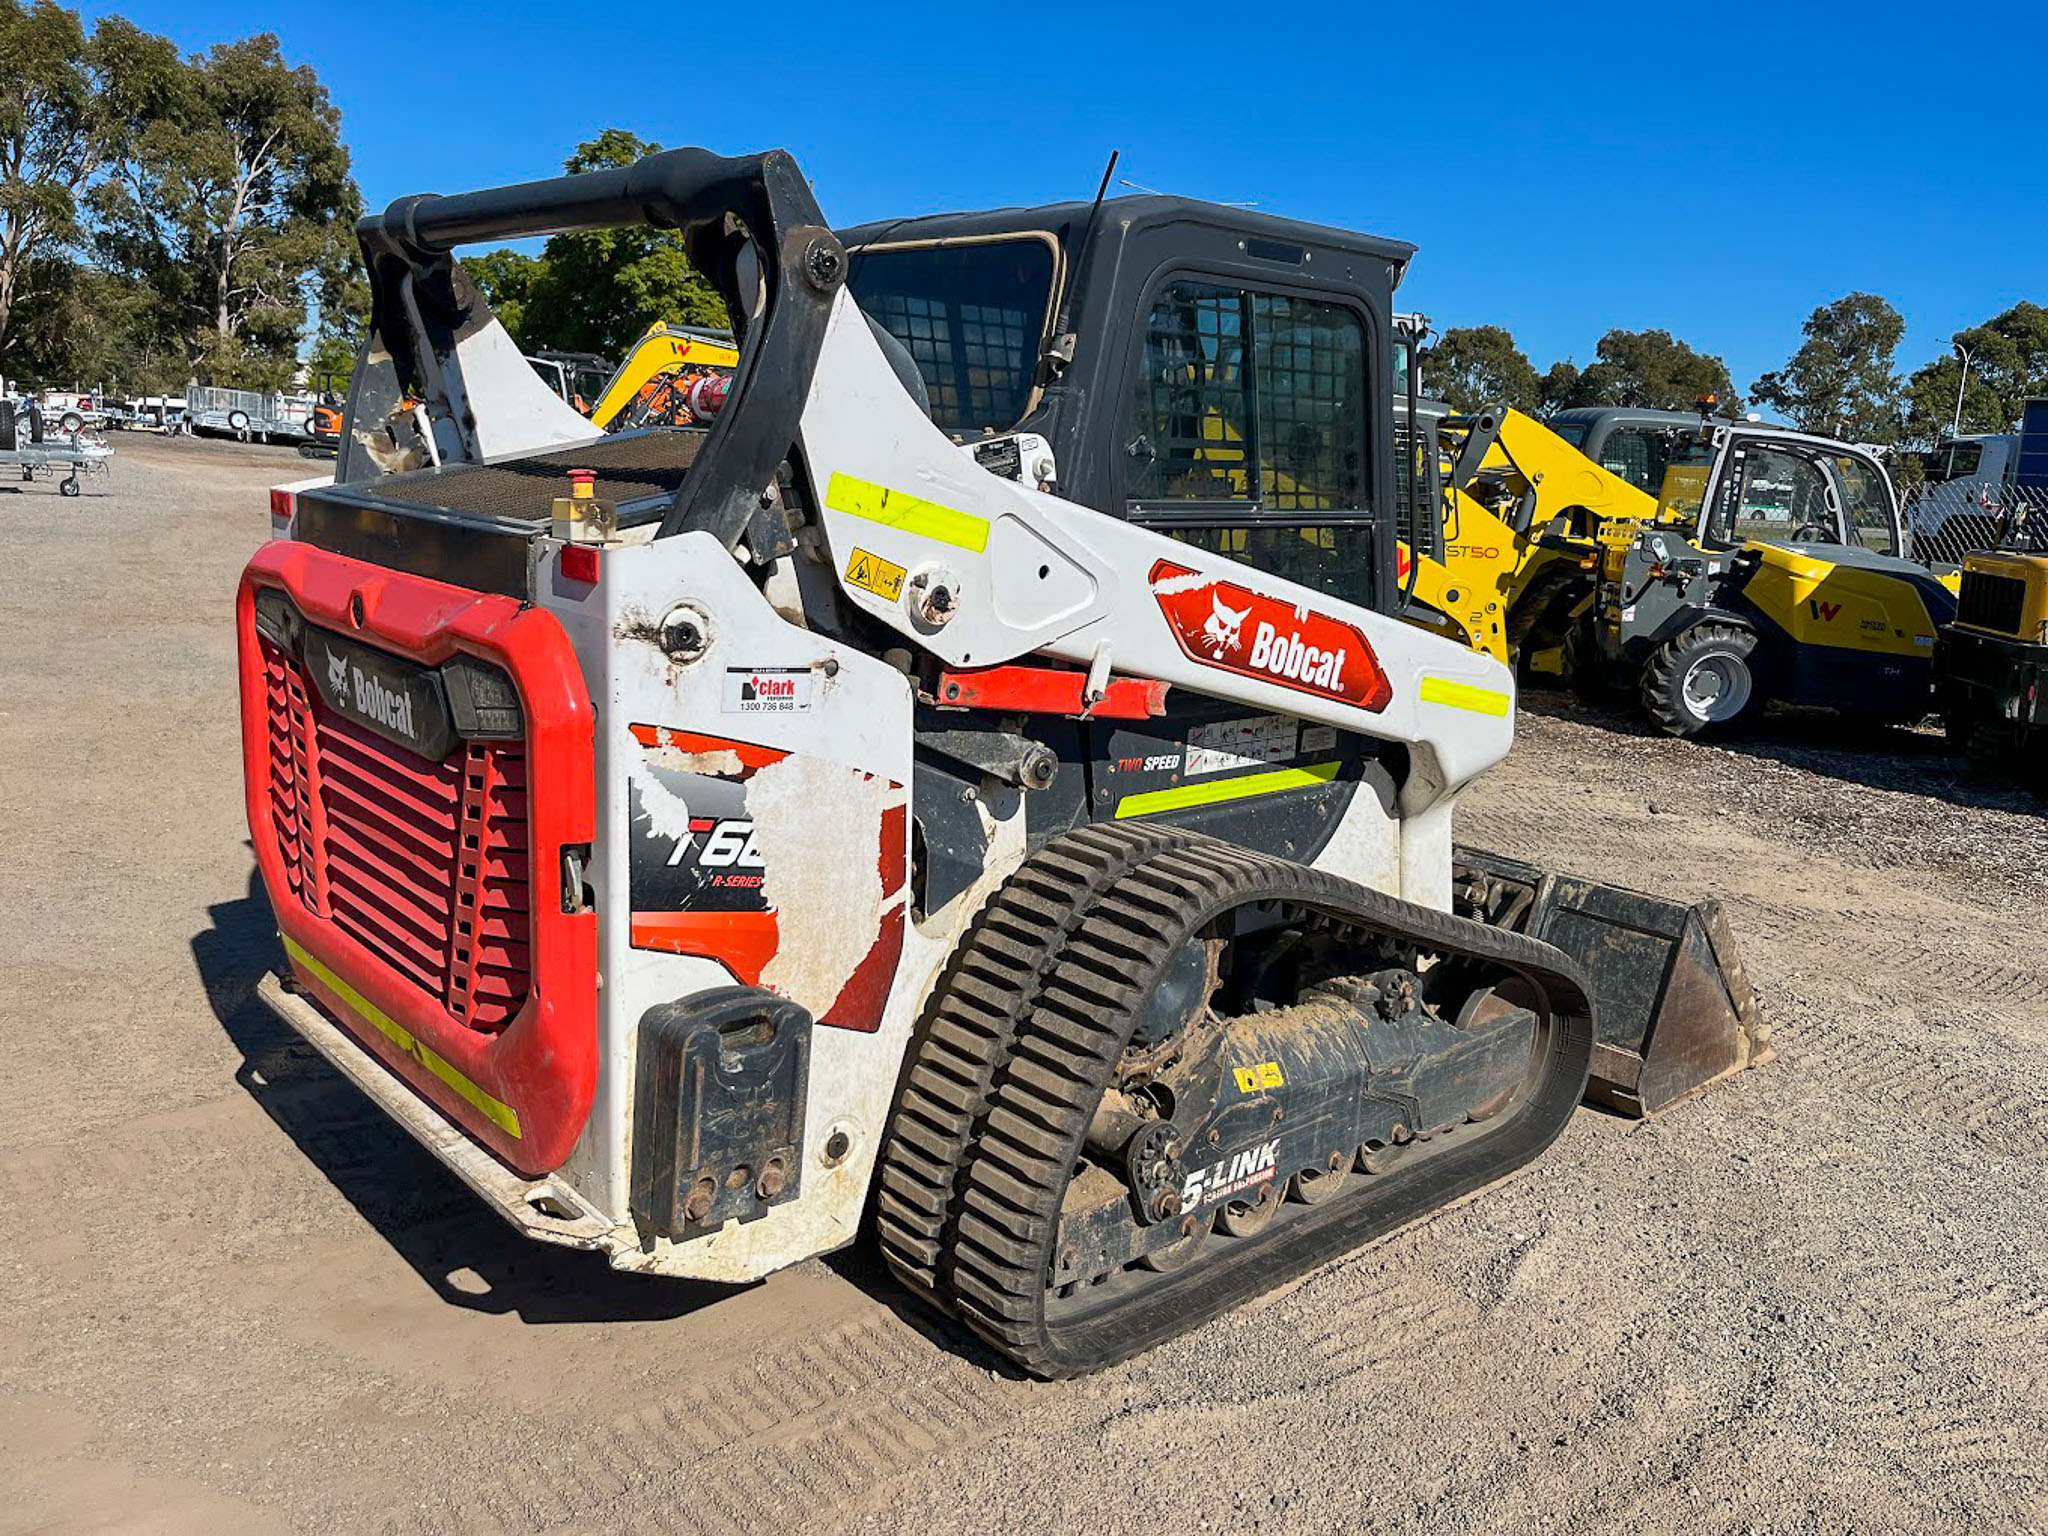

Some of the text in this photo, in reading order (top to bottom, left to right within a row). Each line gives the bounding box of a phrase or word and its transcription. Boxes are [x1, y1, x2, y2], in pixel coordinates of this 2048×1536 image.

[1446, 545, 1500, 559] ST50
[1249, 621, 1346, 691] Bobcat
[759, 679, 795, 696] clark
[352, 666, 415, 739] Bobcat
[740, 702, 760, 711] 1300
[1118, 755, 1181, 772] TWO SPEED
[712, 875, 762, 887] R-SERIES
[1180, 1137, 1281, 1214] 5-LINK
